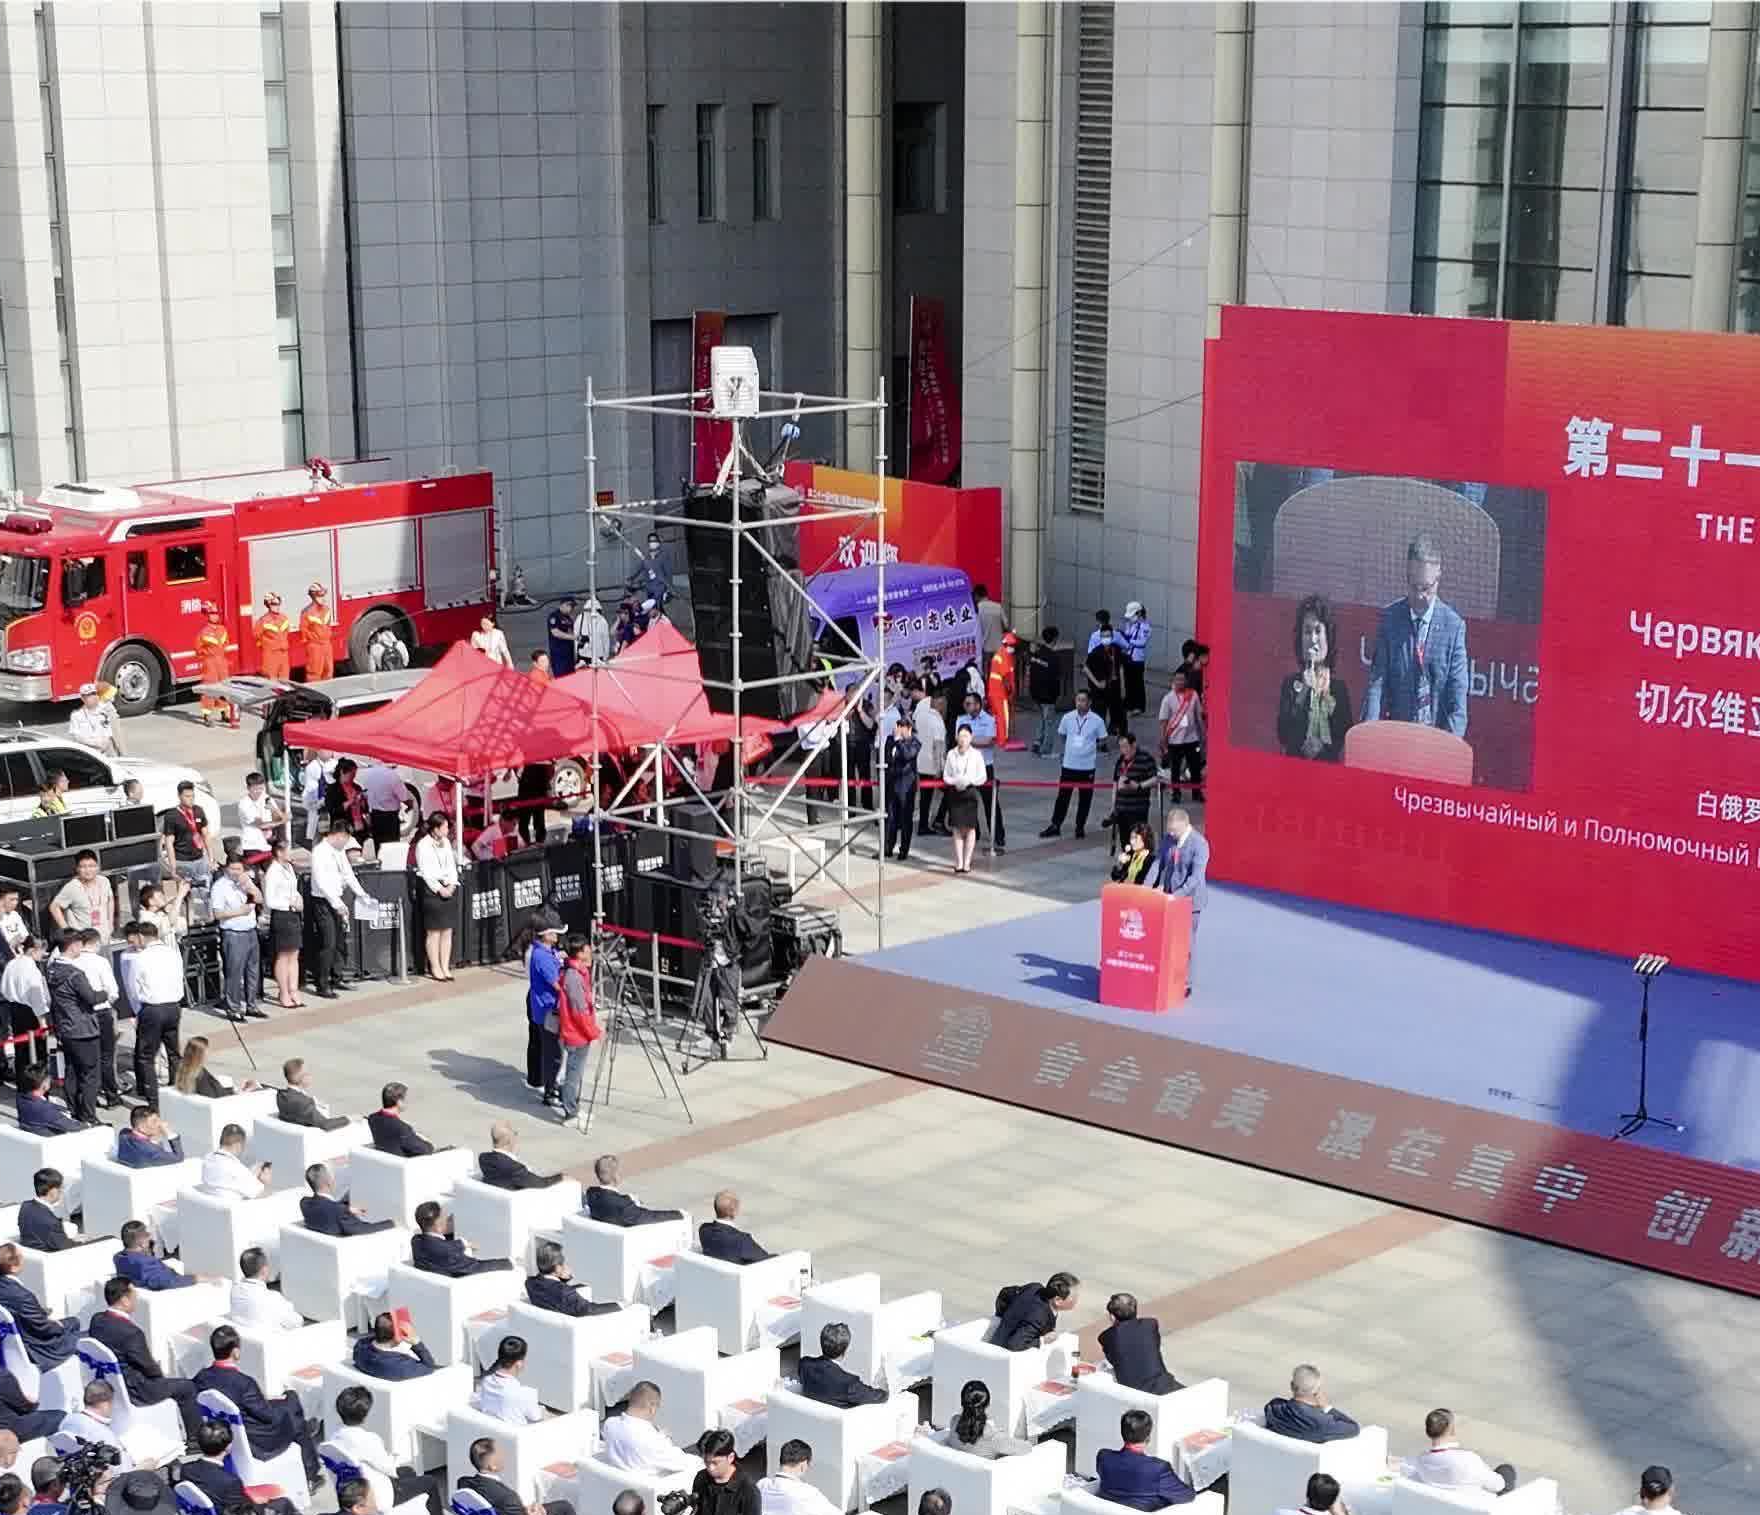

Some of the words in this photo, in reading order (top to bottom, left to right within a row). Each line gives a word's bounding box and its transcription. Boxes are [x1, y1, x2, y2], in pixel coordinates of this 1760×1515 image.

[1696, 512, 1754, 545] THE
[1393, 785, 1559, 836] Чрезвычайный
[1564, 817, 1578, 835] и
[1583, 816, 1751, 868] Полномочный
